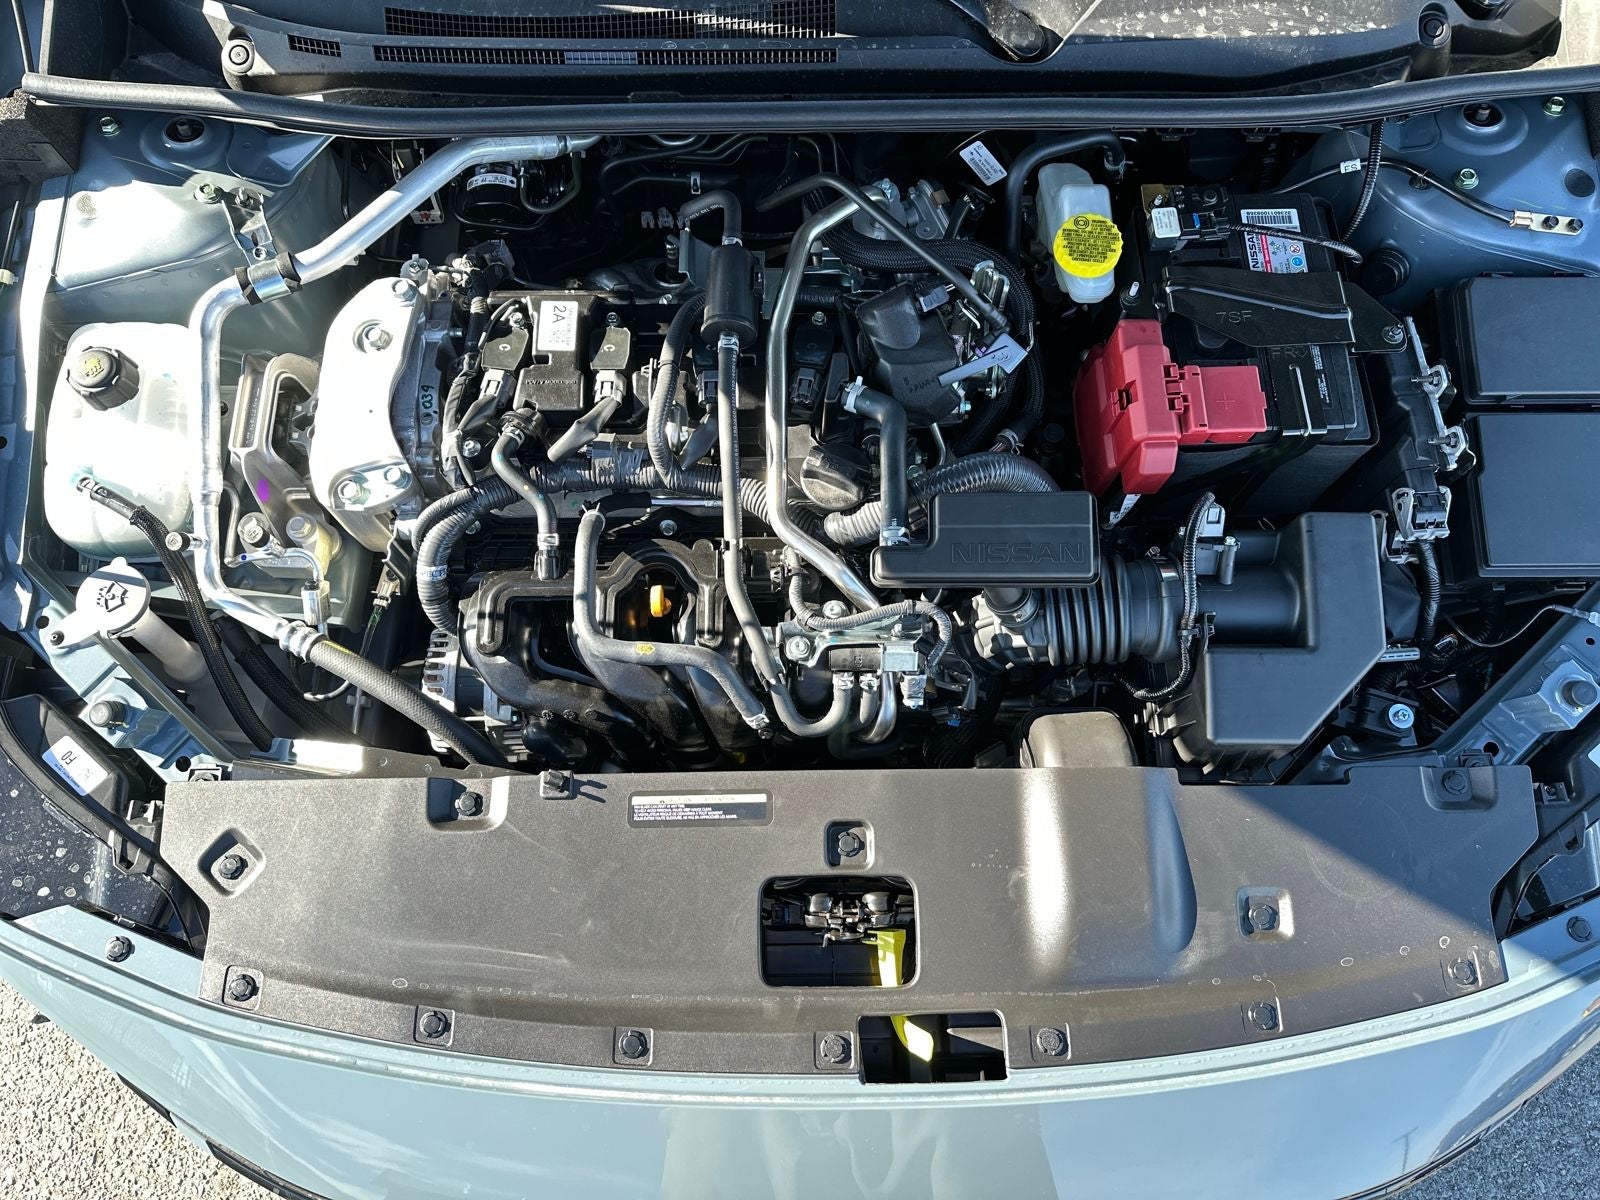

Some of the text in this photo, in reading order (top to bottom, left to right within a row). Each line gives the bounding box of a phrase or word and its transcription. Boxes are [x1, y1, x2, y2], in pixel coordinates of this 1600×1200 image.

[552, 304, 568, 323] 2A
[1216, 310, 1252, 324] 7SF
[951, 542, 1086, 564] NISSAN
